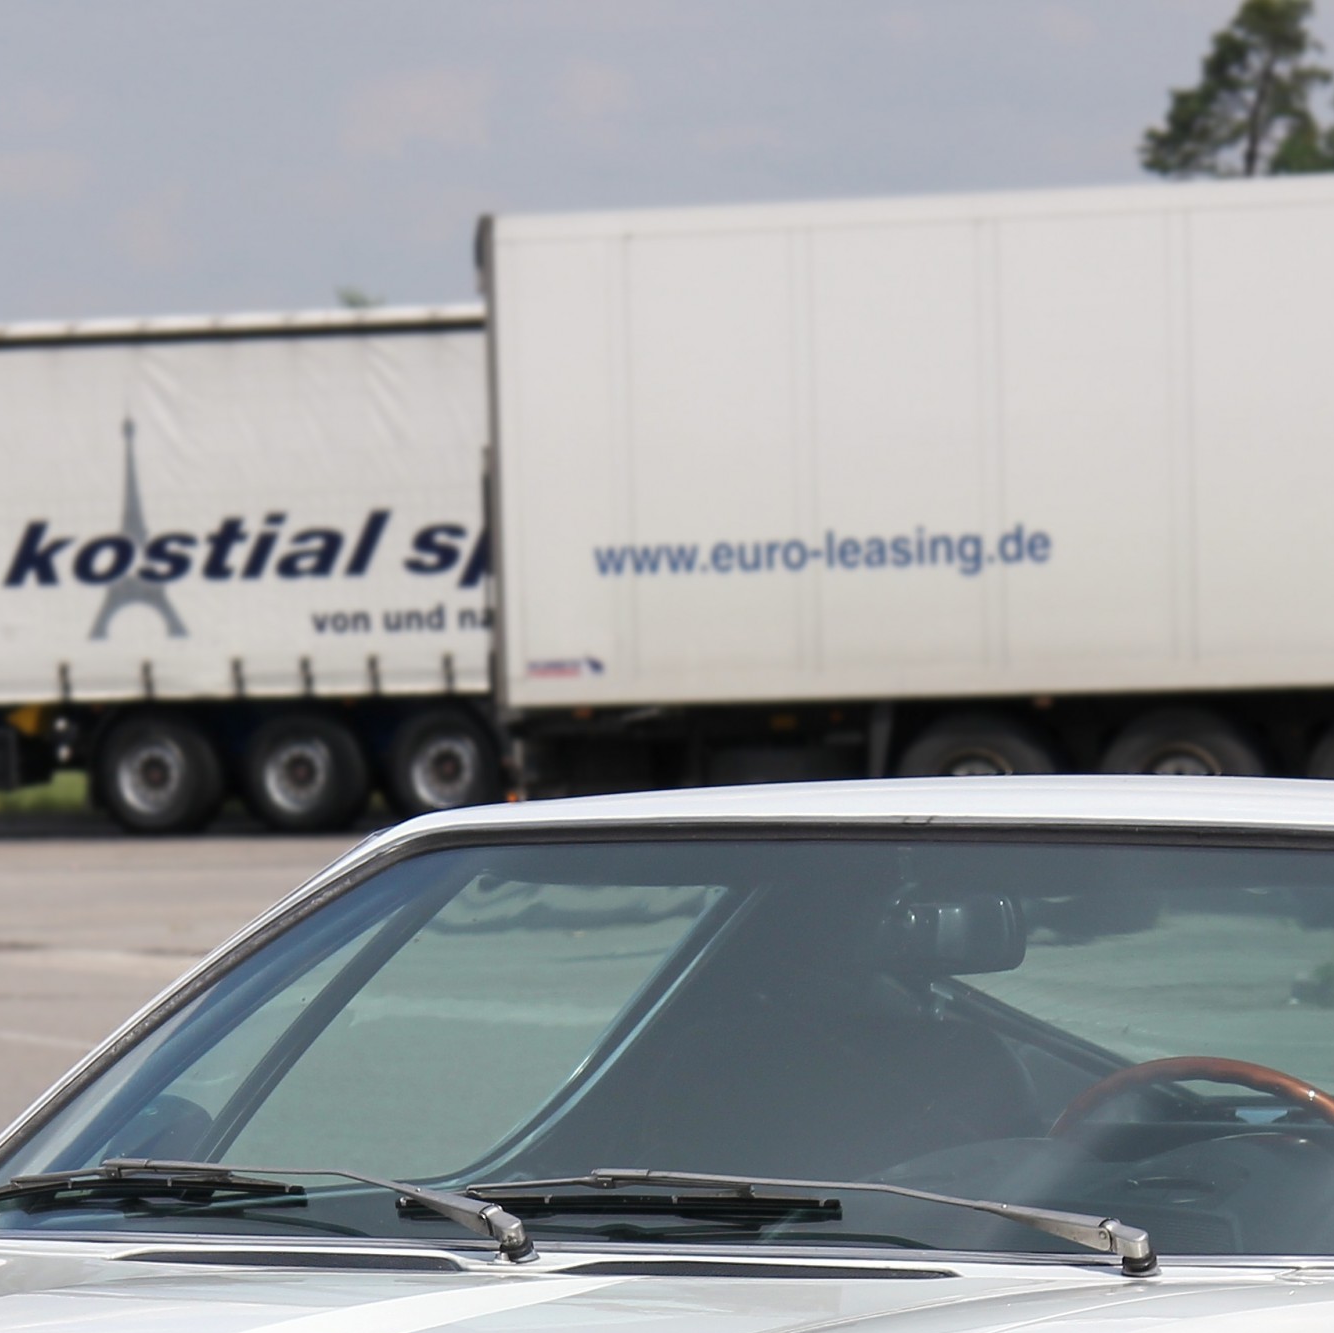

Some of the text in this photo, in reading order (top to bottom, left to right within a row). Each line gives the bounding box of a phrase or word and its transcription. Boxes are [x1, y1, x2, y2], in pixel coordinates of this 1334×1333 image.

[2, 510, 393, 587] kostial
[593, 524, 1053, 577] www.euro-leasing.de
[311, 611, 370, 634] von
[383, 602, 445, 632] und
